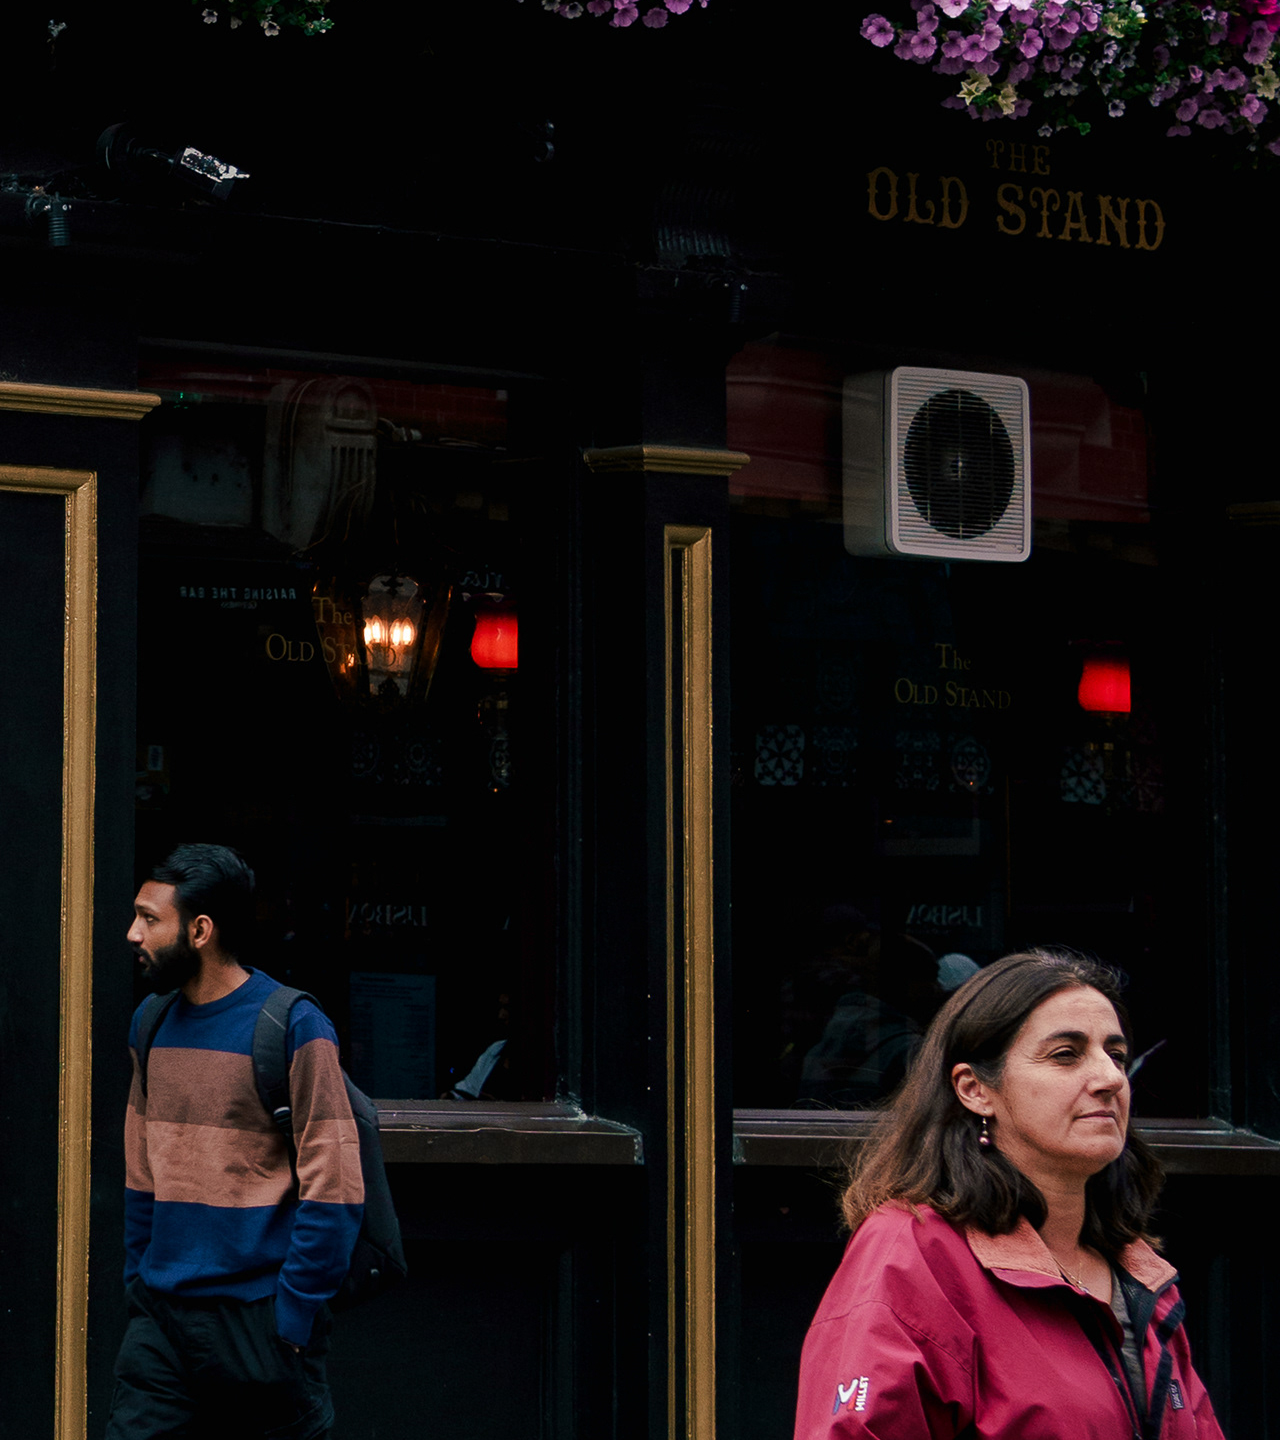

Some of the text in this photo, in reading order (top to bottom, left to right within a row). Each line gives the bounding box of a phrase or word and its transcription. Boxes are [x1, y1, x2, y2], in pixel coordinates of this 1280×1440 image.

[985, 138, 1051, 176] THE
[866, 166, 1167, 252] OLD STAND
[311, 596, 353, 625] The
[265, 633, 315, 663] OLD
[935, 642, 972, 671] The
[894, 677, 1012, 710] OLD STAND
[854, 1375, 870, 1412] MILLET
